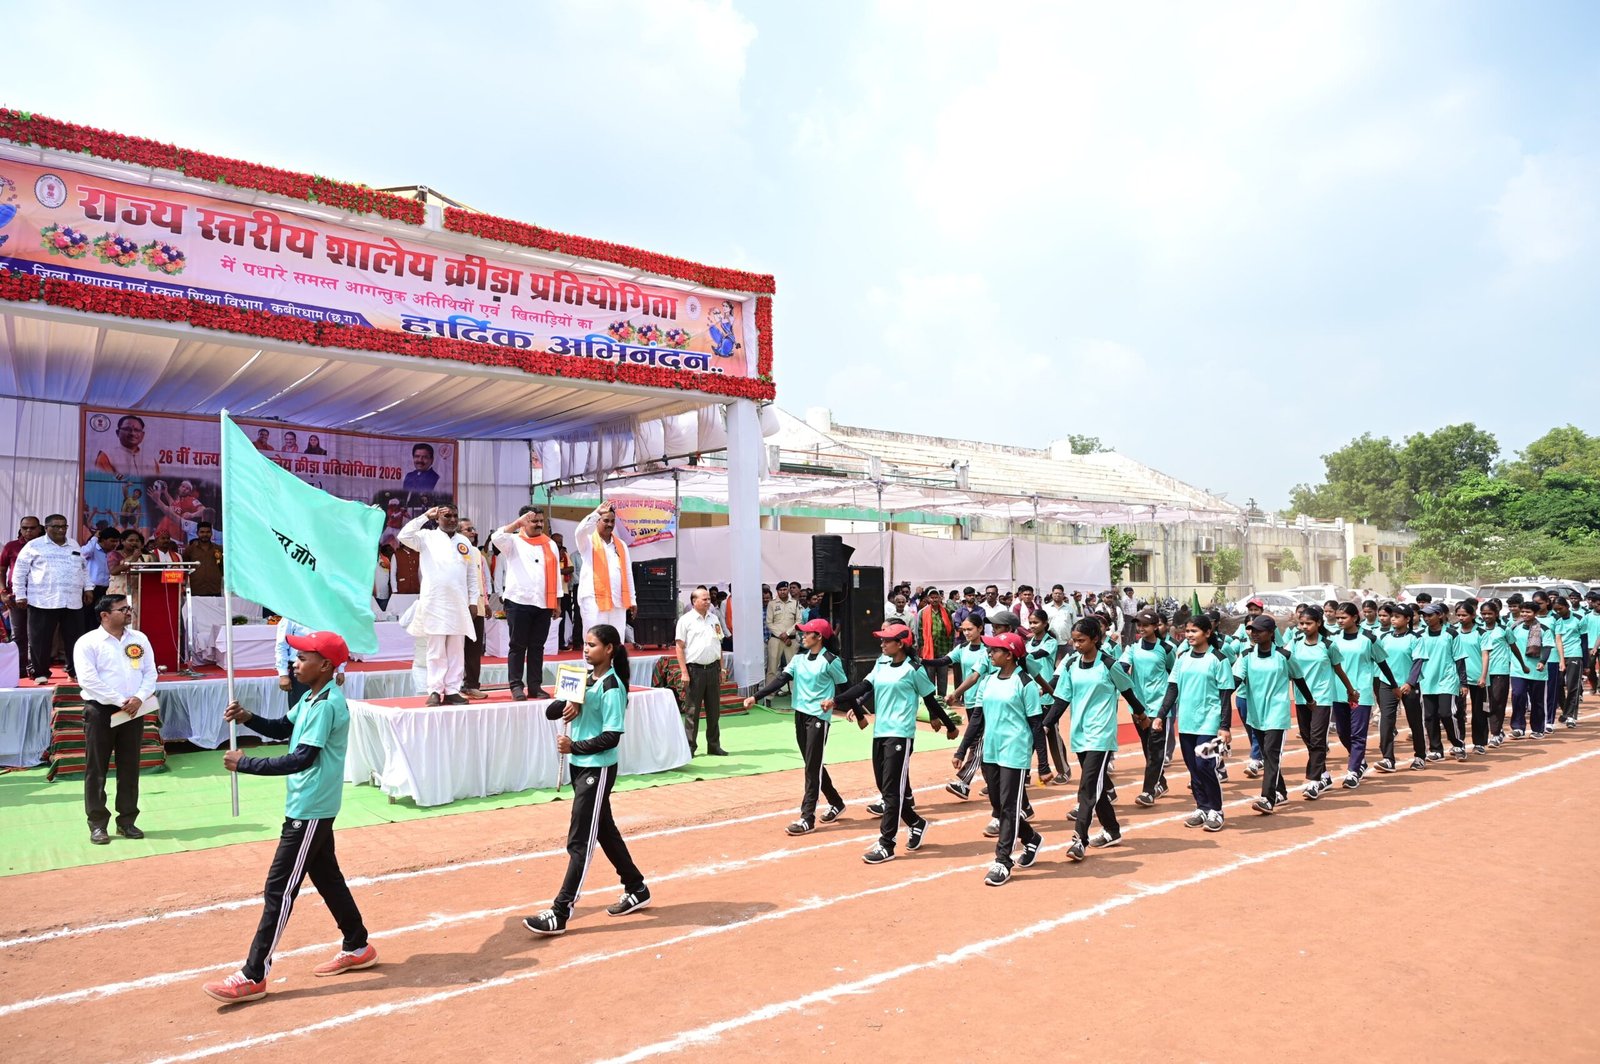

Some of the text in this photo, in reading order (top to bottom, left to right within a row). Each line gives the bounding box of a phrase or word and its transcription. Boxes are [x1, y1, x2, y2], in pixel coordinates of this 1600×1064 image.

[76, 185, 188, 235] राज्य
[197, 207, 320, 260] स्तरीय
[325, 234, 438, 282] शालेय
[445, 254, 522, 302] क्रीड़ा
[530, 269, 679, 321] प्रतियोगिता
[220, 255, 237, 273] में
[242, 262, 288, 282] पधारे
[293, 271, 339, 291] समस्त
[413, 291, 476, 313] अतिथियों
[479, 304, 500, 318] एवं
[511, 305, 573, 328] खिलाड़ियों
[576, 318, 594, 330] का
[270, 302, 324, 321] कबीरधाम
[401, 313, 534, 351] हार्दिक
[159, 450, 173, 465] 26
[176, 446, 191, 465] वीं
[192, 451, 220, 467] राज्य
[294, 456, 321, 478] क्रीड़ा
[322, 459, 377, 479] प्रतियोगिता
[379, 466, 403, 481] 2026
